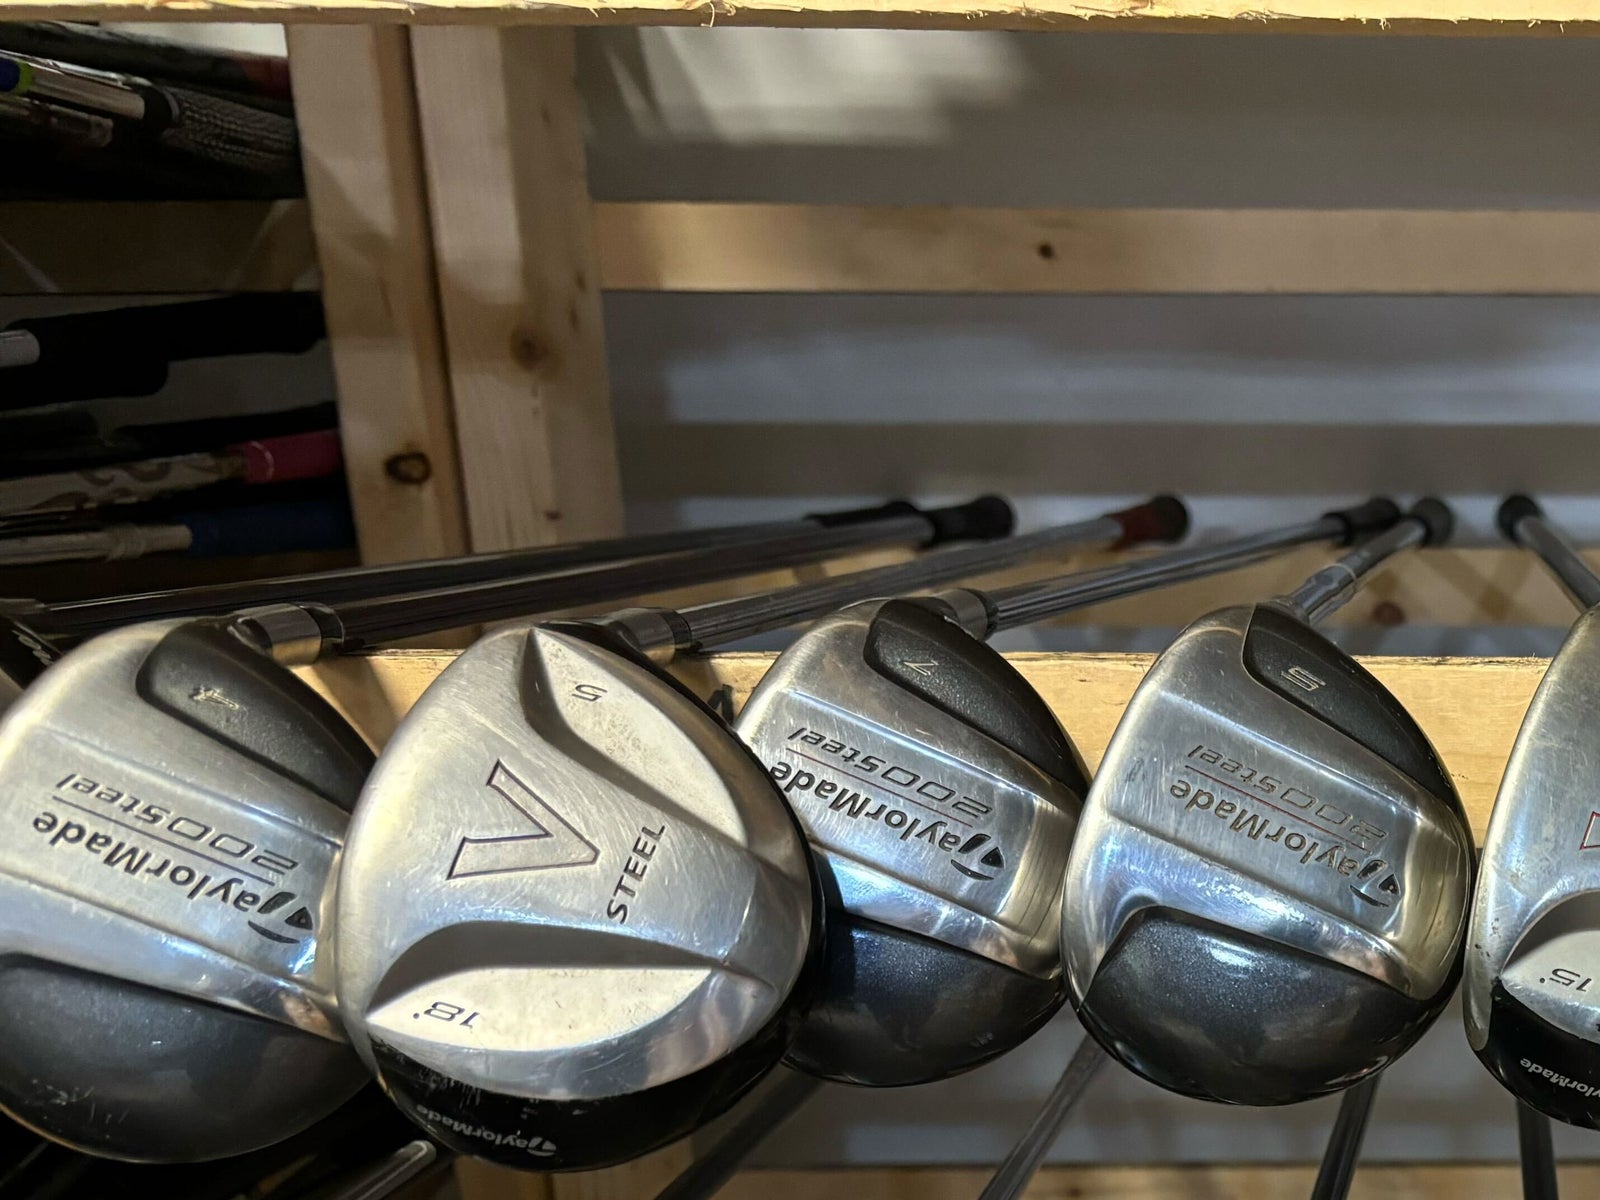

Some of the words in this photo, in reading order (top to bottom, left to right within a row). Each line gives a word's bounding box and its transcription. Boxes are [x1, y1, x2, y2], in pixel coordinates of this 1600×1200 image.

[572, 683, 608, 703] 5
[33, 811, 313, 944] TaylorMade
[446, 758, 601, 881] V
[606, 825, 667, 924] STEEL
[770, 761, 1005, 881] TaylorMade
[1169, 780, 1401, 907] TaylorMade
[416, 1104, 557, 1157] TaylorMade
